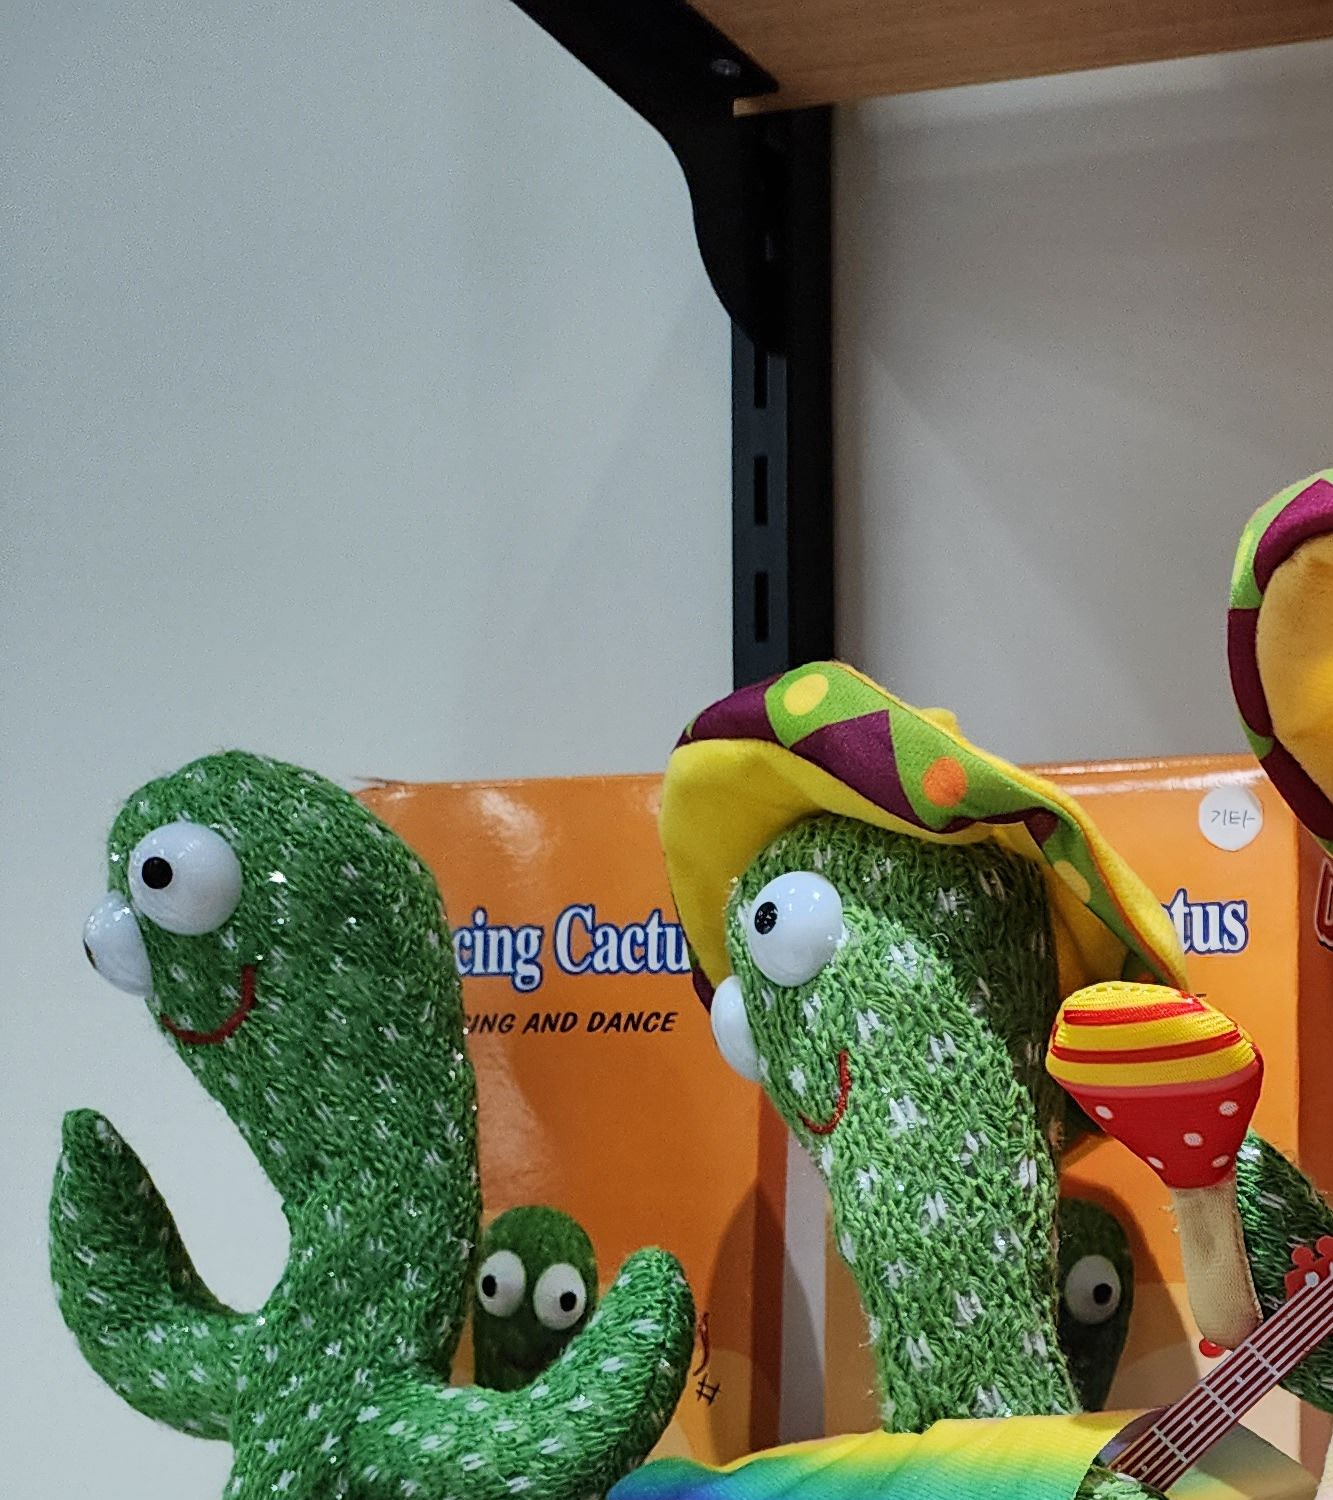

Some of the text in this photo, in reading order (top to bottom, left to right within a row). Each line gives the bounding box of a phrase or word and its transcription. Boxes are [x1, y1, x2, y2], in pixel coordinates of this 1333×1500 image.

[1210, 809, 1256, 829] 기타
[1162, 888, 1249, 955] tus
[453, 903, 690, 992] cing Cactu
[522, 1011, 578, 1034] AND
[586, 1010, 679, 1034] DANCE
